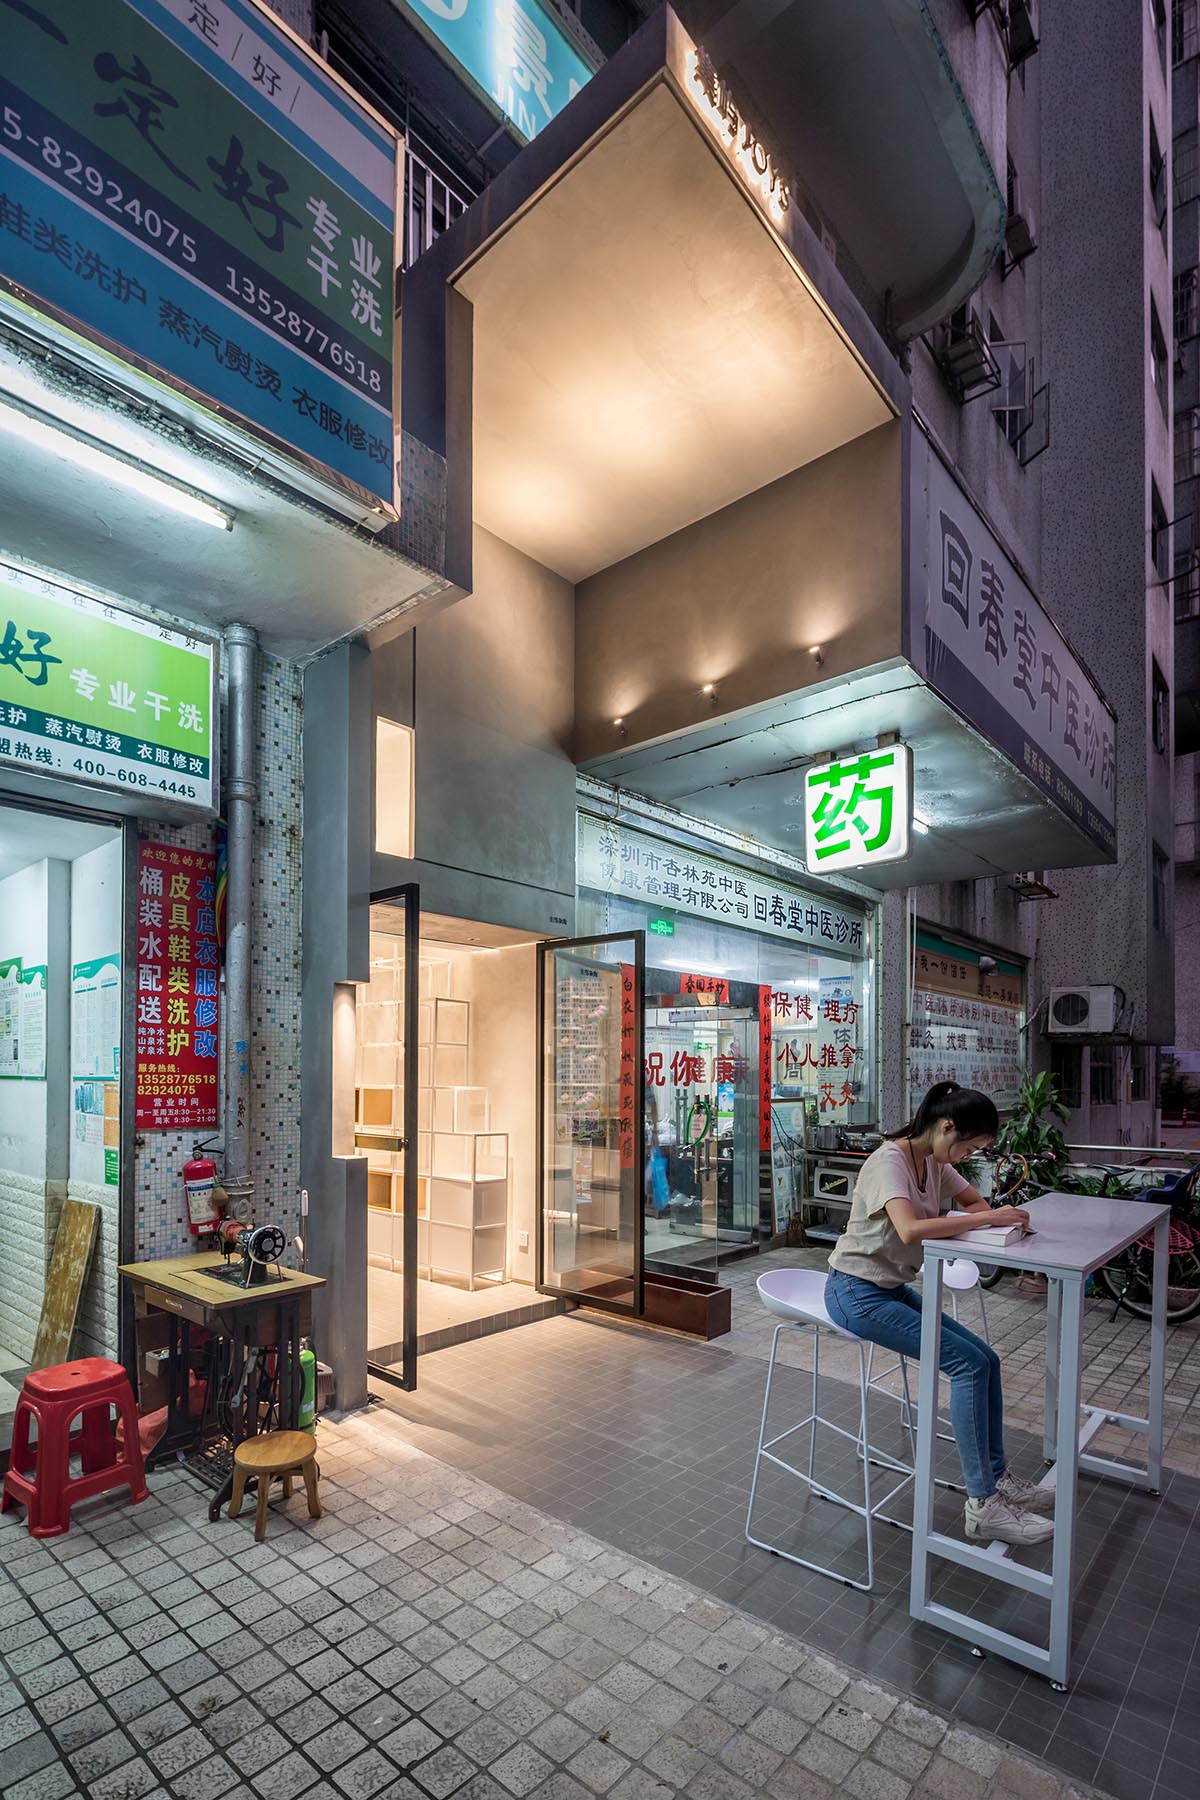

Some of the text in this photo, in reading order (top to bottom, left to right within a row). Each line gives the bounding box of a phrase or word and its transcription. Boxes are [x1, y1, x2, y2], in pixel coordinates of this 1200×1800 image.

[226, 266, 381, 393] 13528776518
[158, 296, 283, 402] 蒸汽熨烫
[293, 386, 390, 471] 衣服修改
[939, 508, 1117, 792] 回春堂中医诊所
[69, 667, 204, 733] 专业干洗
[45, 717, 122, 753] 蒸汽熨烫
[137, 743, 204, 775] 衣服修改
[73, 758, 196, 798] 400-608-4445
[808, 752, 894, 861] 药
[138, 866, 163, 1024] 桶装水配送
[754, 893, 863, 950] 回春堂中医诊所
[167, 871, 190, 1057] 皮具鞋类洗护
[194, 876, 217, 1058] 本店衣服修改
[137, 1074, 216, 1085] 13528776518
[776, 1042, 857, 1069] 小儿推拿
[137, 1085, 196, 1096] 82924075
[153, 1097, 199, 1107] 营业时间
